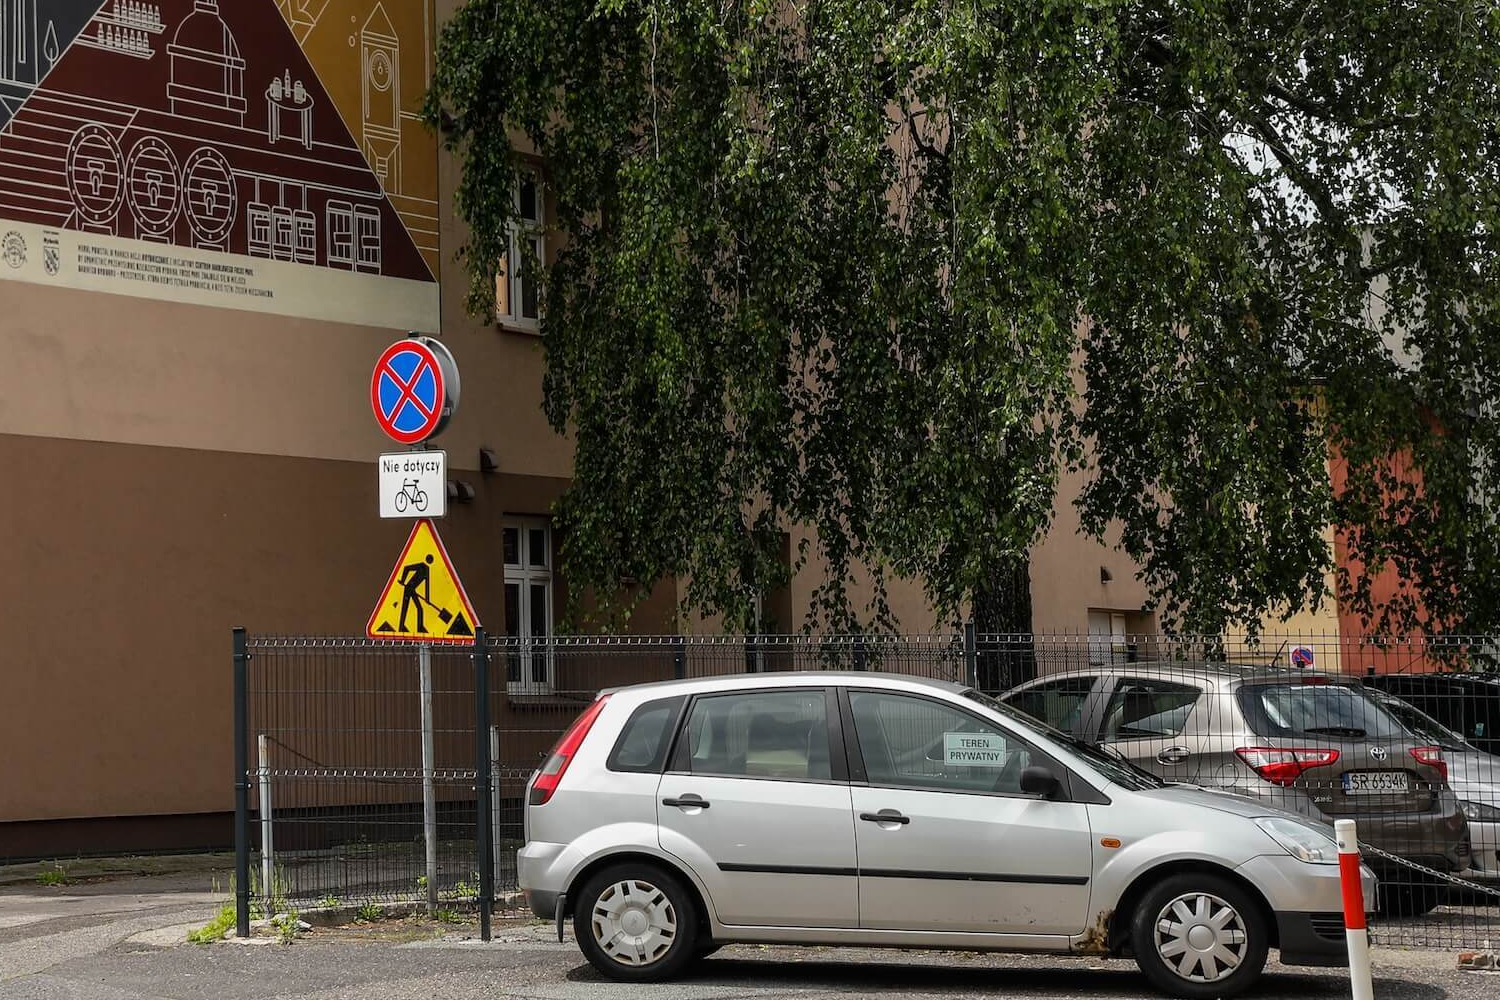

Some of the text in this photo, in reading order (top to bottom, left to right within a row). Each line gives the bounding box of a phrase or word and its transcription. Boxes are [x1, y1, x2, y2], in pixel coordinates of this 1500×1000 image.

[383, 459, 440, 475] Nie dotyczy
[960, 739, 990, 748] TEREN
[950, 751, 1000, 761] PRYWATNY
[1352, 774, 1368, 790] SR
